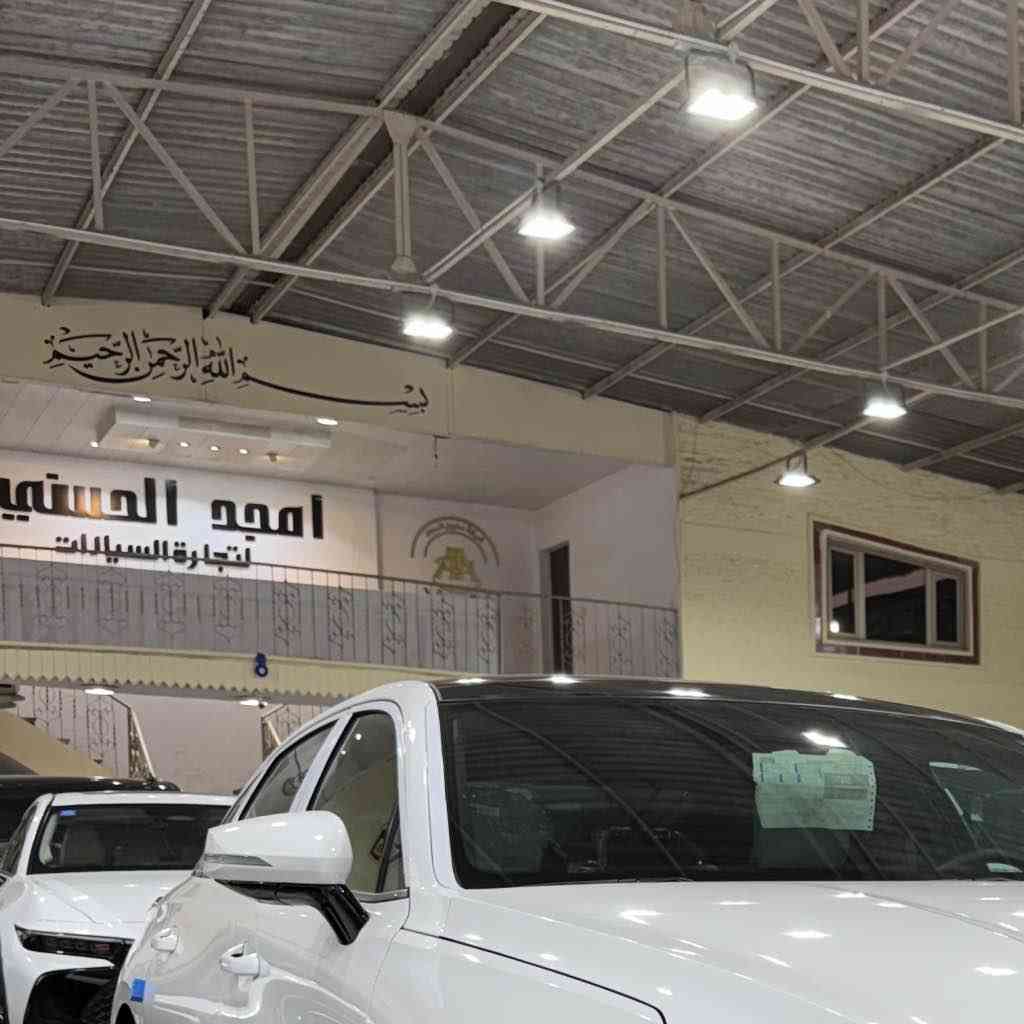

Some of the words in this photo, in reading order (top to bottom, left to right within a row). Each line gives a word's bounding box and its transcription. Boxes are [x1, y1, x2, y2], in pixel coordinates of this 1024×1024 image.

[211, 494, 324, 542] امجد
[55, 533, 169, 564] السيارات
[173, 540, 251, 573] لتجارة
